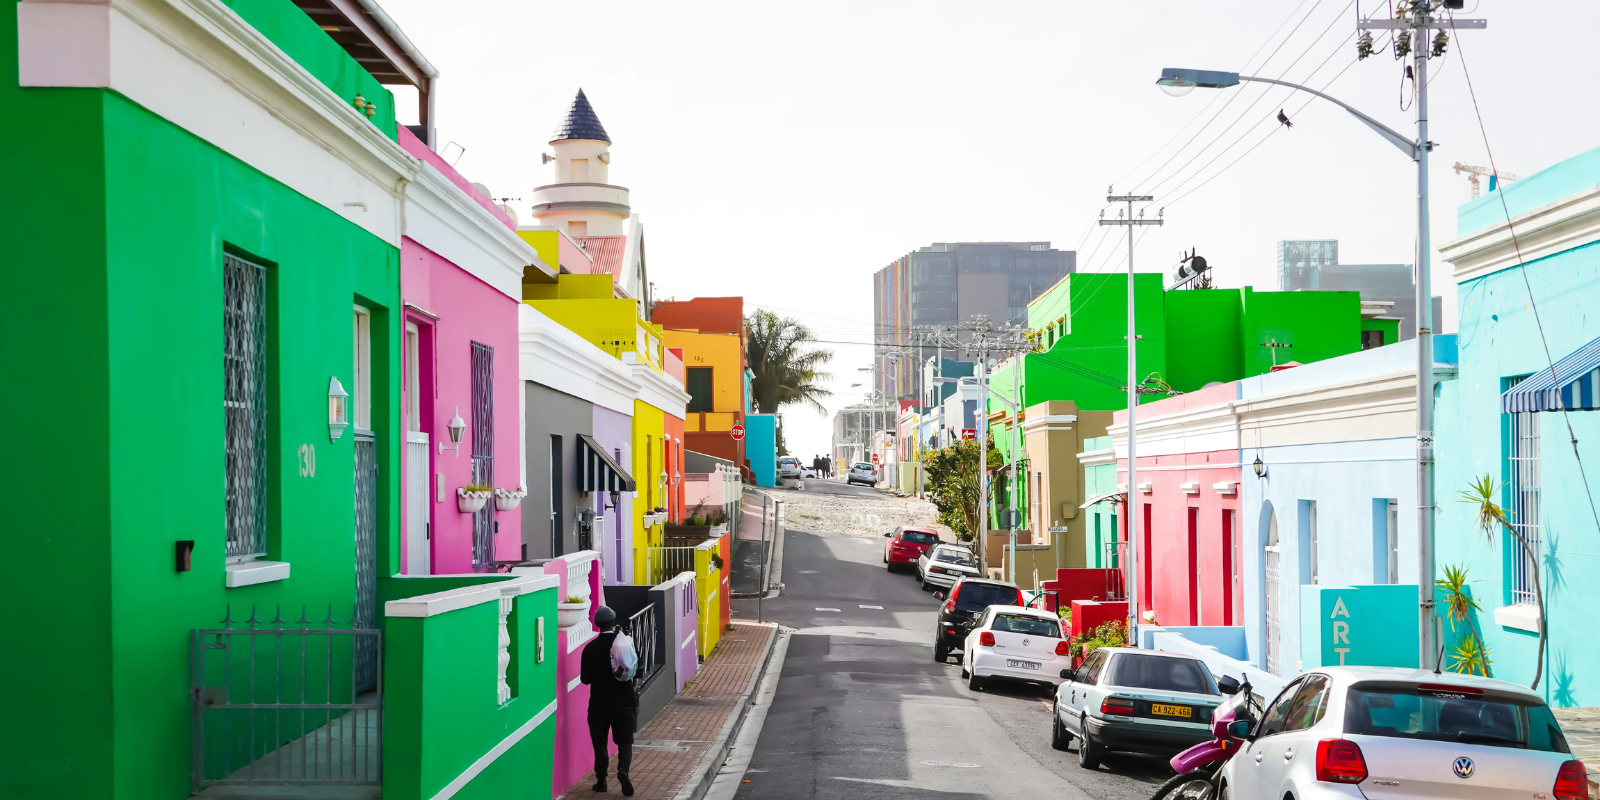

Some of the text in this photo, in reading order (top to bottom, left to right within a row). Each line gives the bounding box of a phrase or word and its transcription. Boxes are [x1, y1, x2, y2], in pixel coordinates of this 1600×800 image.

[296, 443, 316, 478] 130
[1330, 595, 1351, 667] ART
[1153, 705, 1162, 714] CA
